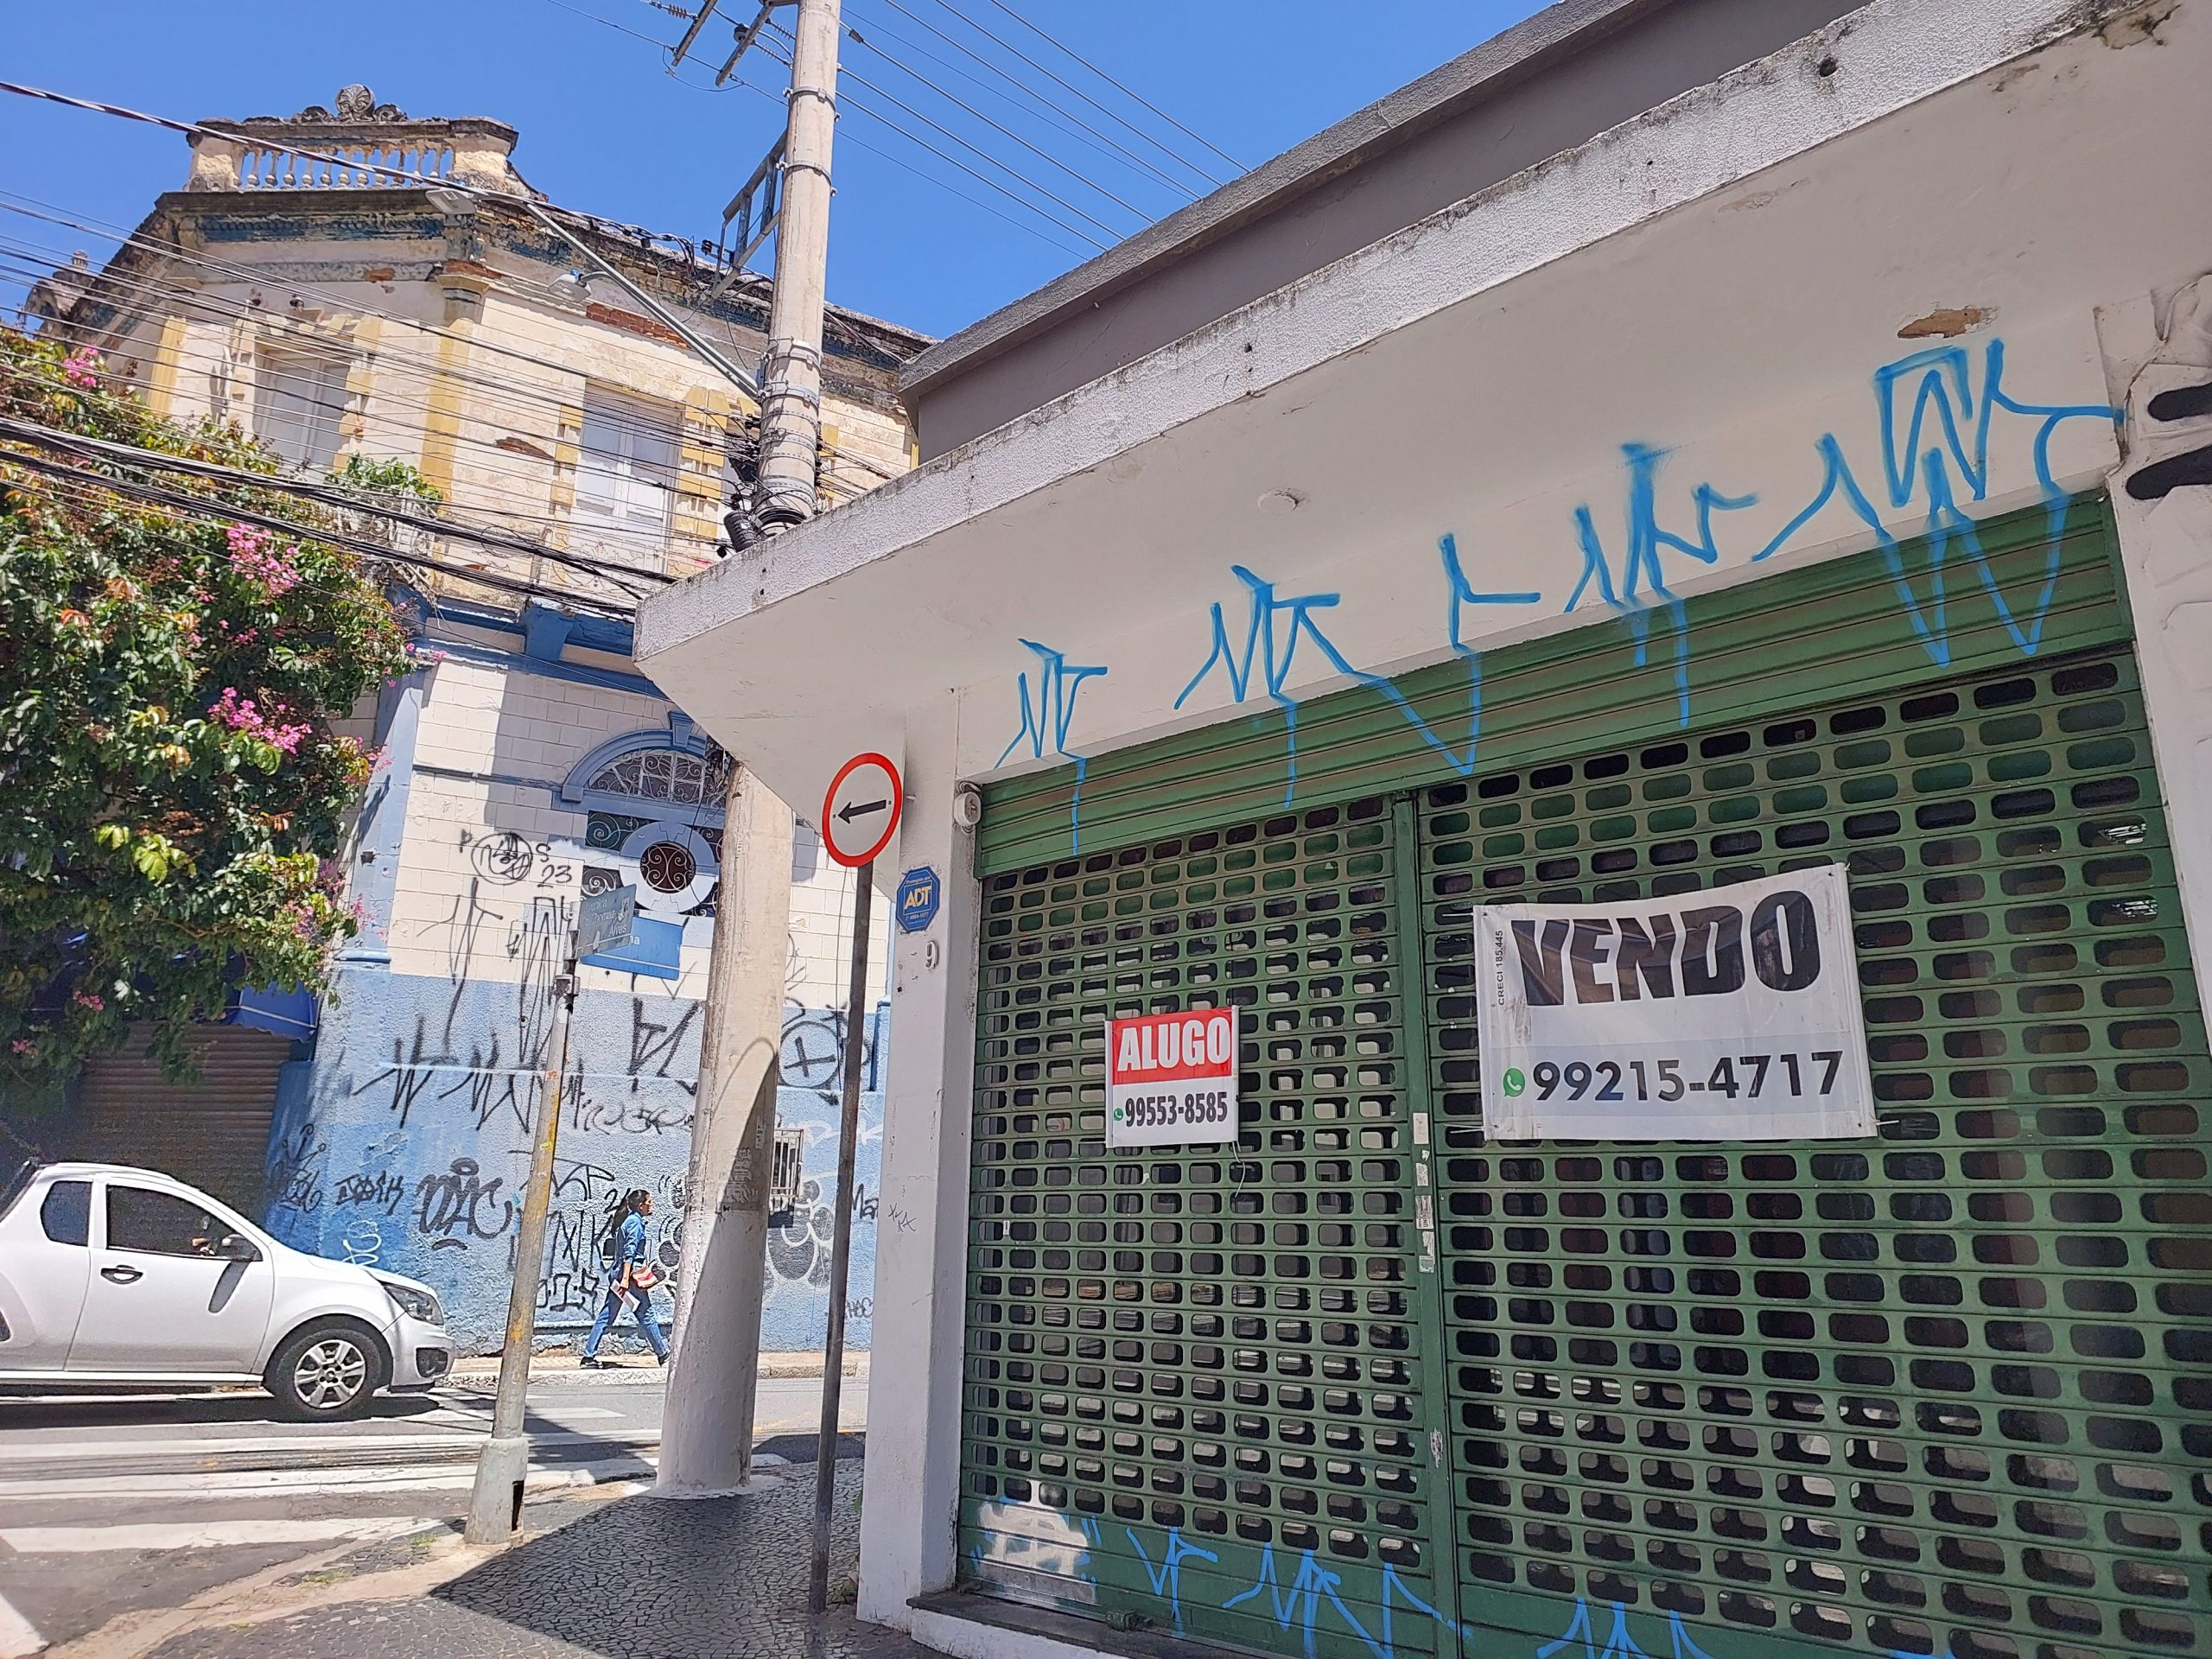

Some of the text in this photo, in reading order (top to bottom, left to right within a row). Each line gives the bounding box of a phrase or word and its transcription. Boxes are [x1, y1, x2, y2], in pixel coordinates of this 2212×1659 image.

[904, 886, 931, 910] ADT
[607, 923, 627, 938] Alves
[1495, 930, 1503, 968] 185.445
[1510, 890, 1821, 1007] VENDO
[926, 939, 939, 969] 9
[1116, 1016, 1231, 1072] ALUGO
[1532, 1050, 1844, 1103] 99215-4717
[1125, 1091, 1228, 1128] 99553-8585
